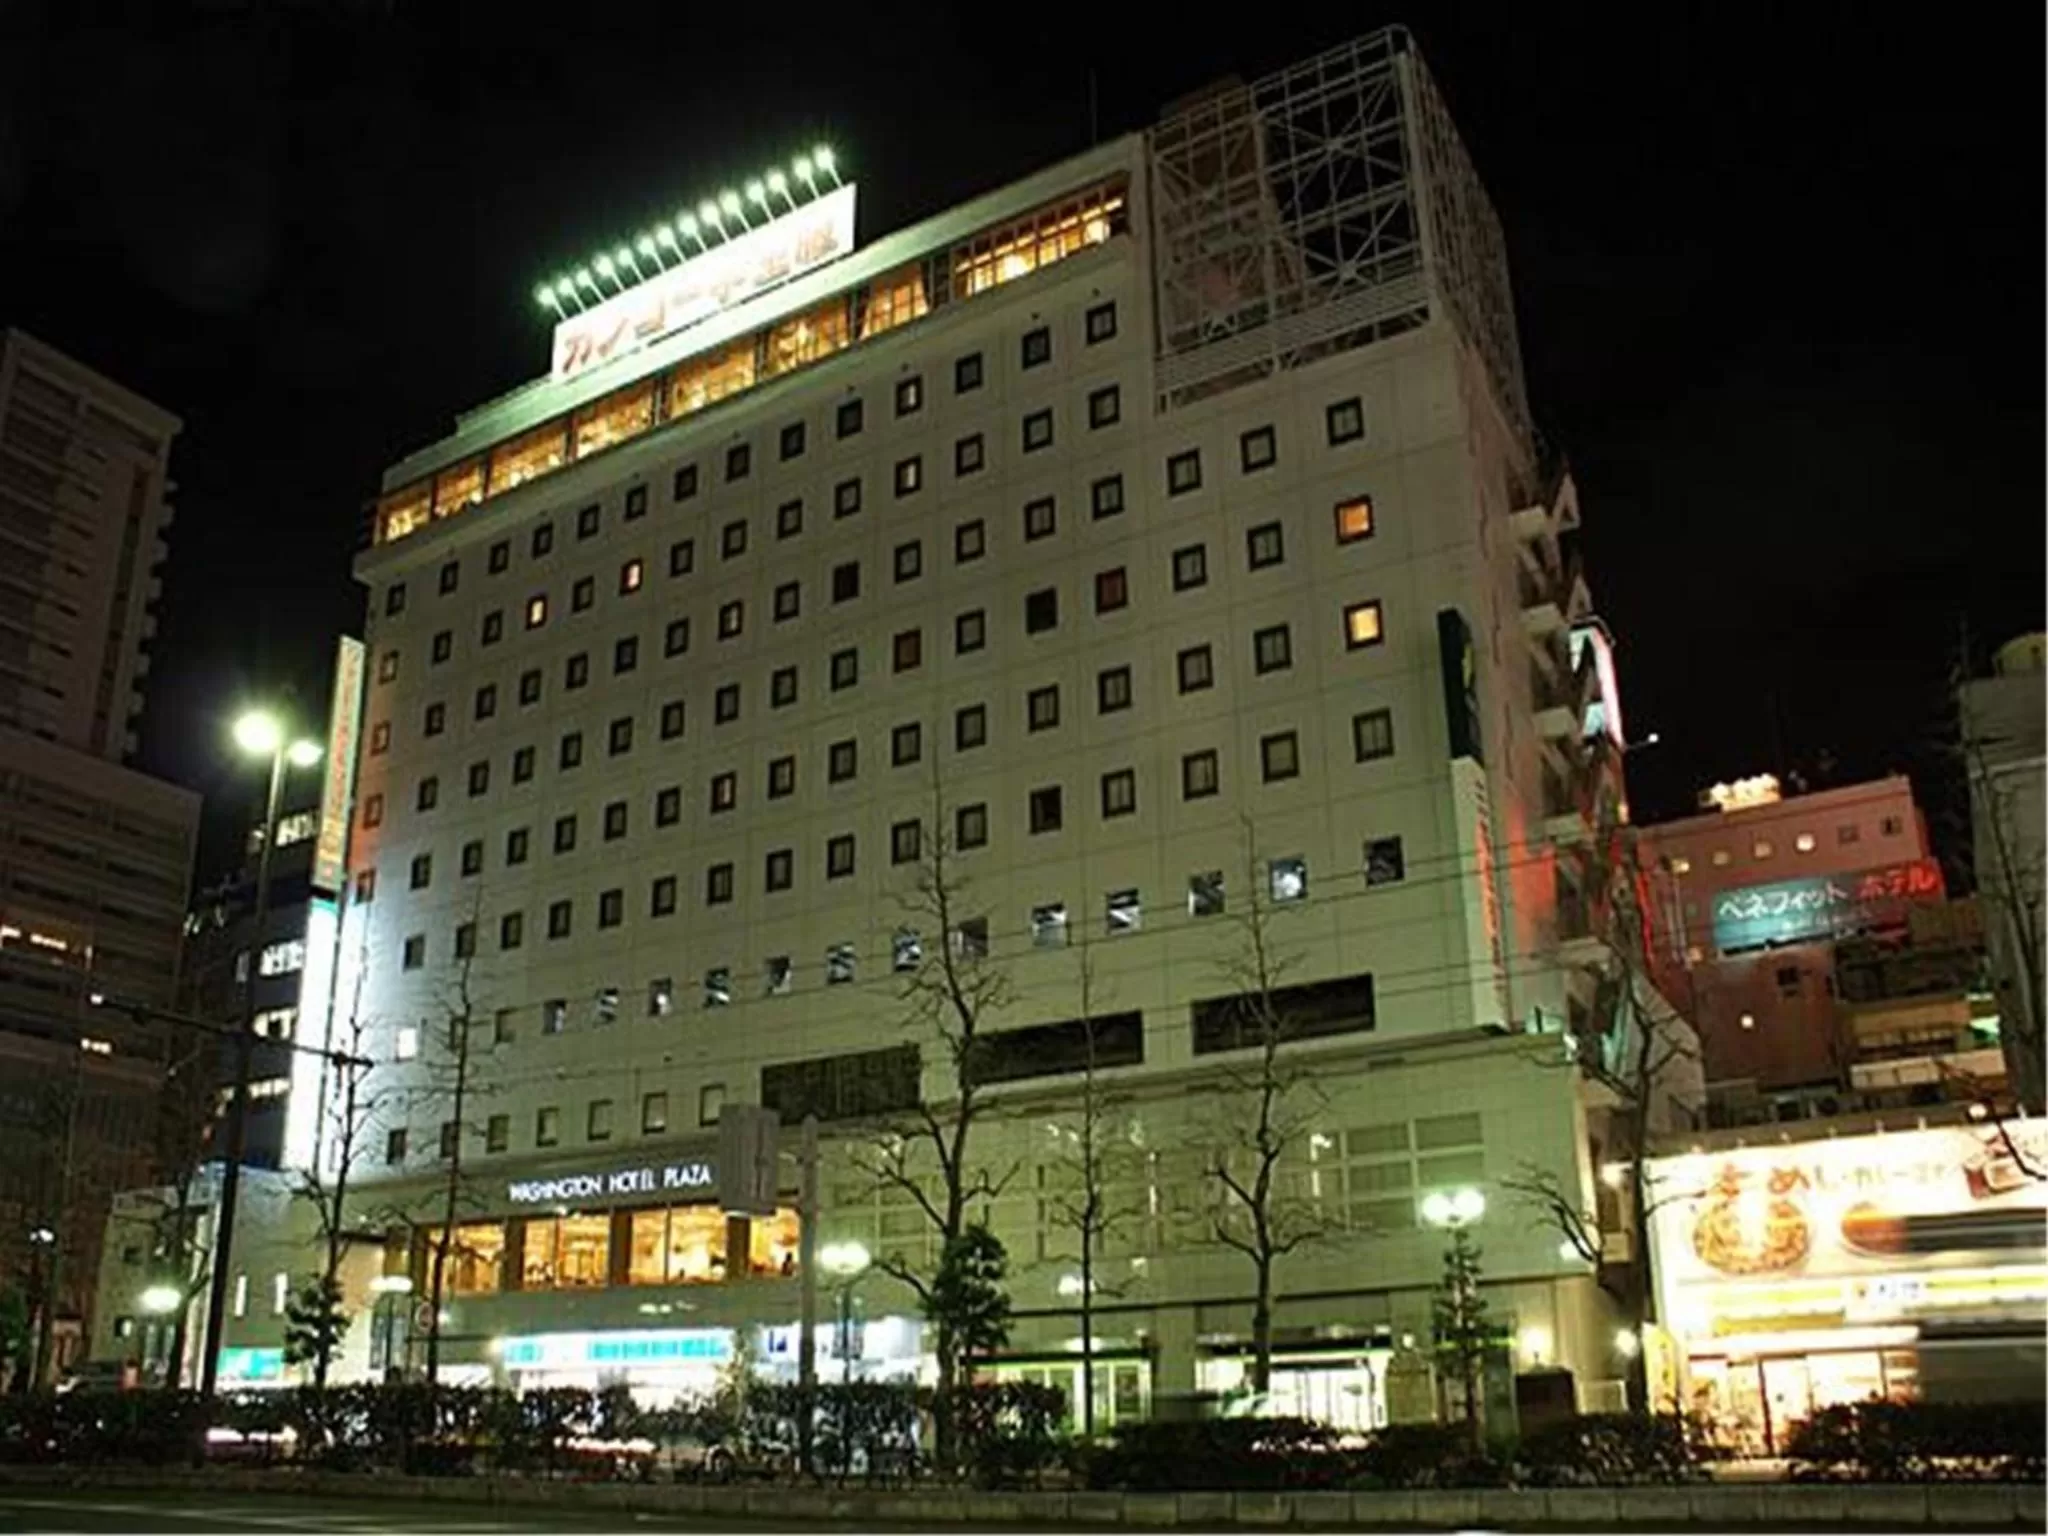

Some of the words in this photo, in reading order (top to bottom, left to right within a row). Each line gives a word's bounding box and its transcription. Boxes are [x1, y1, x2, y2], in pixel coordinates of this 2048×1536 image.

[1719, 881, 1849, 920] ベネフィット
[1859, 865, 1937, 899] ホテル
[508, 1175, 601, 1202] WASHINGTON
[609, 1168, 654, 1193] HOTEL
[663, 1163, 713, 1188] PLAZA
